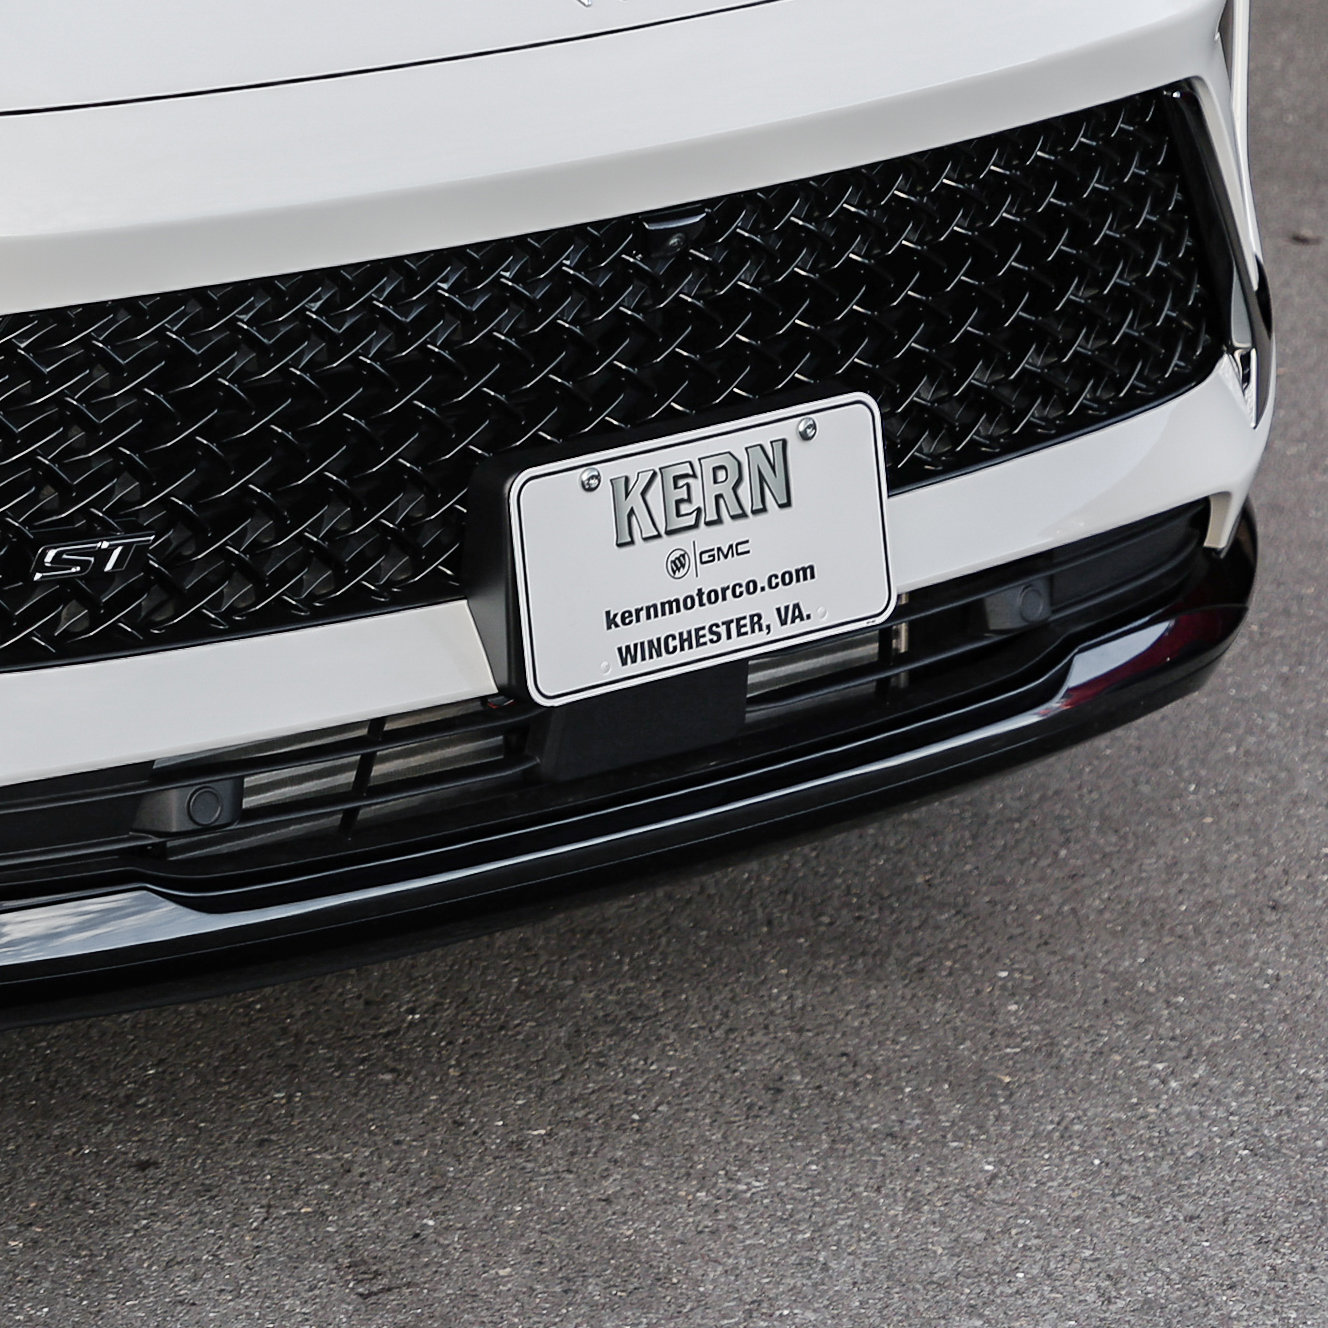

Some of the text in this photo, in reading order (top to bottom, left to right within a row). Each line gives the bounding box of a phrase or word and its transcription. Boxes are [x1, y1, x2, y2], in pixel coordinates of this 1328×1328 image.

[609, 438, 792, 548] KERN
[29, 532, 155, 581] ST
[698, 539, 751, 566] GMC
[604, 562, 817, 631] kernmotorco.com
[616, 601, 812, 667] WINCHESTER, VA.
